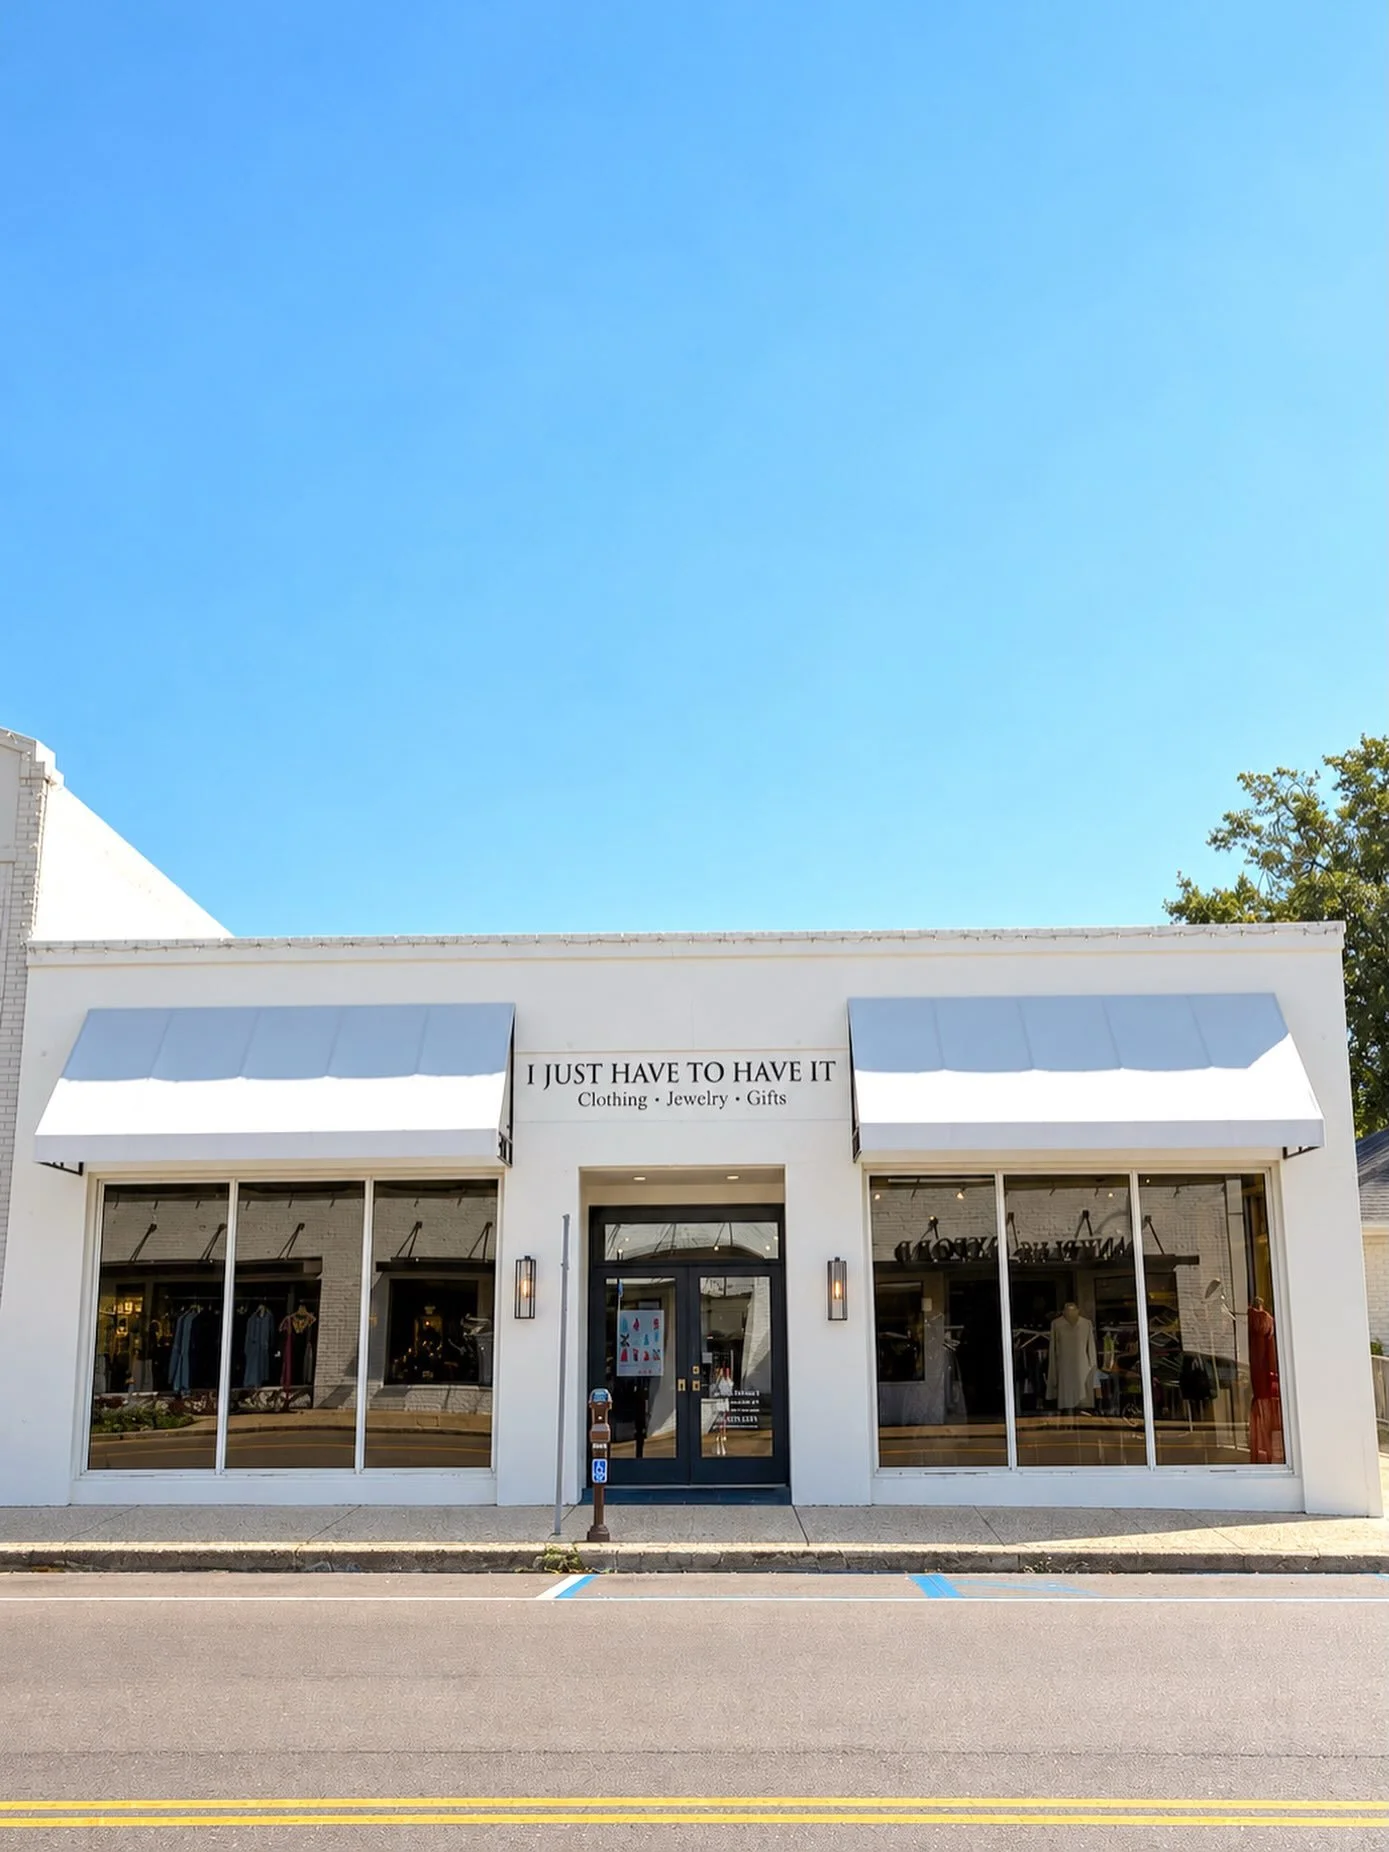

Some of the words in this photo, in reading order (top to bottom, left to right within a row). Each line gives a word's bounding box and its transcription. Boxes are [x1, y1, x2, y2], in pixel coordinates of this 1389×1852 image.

[527, 1063, 536, 1085] I
[543, 1062, 604, 1090] JUST
[611, 1062, 680, 1084] HAVE
[686, 1061, 725, 1083] TO
[733, 1060, 802, 1082] HAVE
[810, 1060, 837, 1082] IT
[577, 1091, 648, 1111] Clothing
[666, 1090, 729, 1110] Jewelry
[746, 1089, 787, 1106] Gifts
